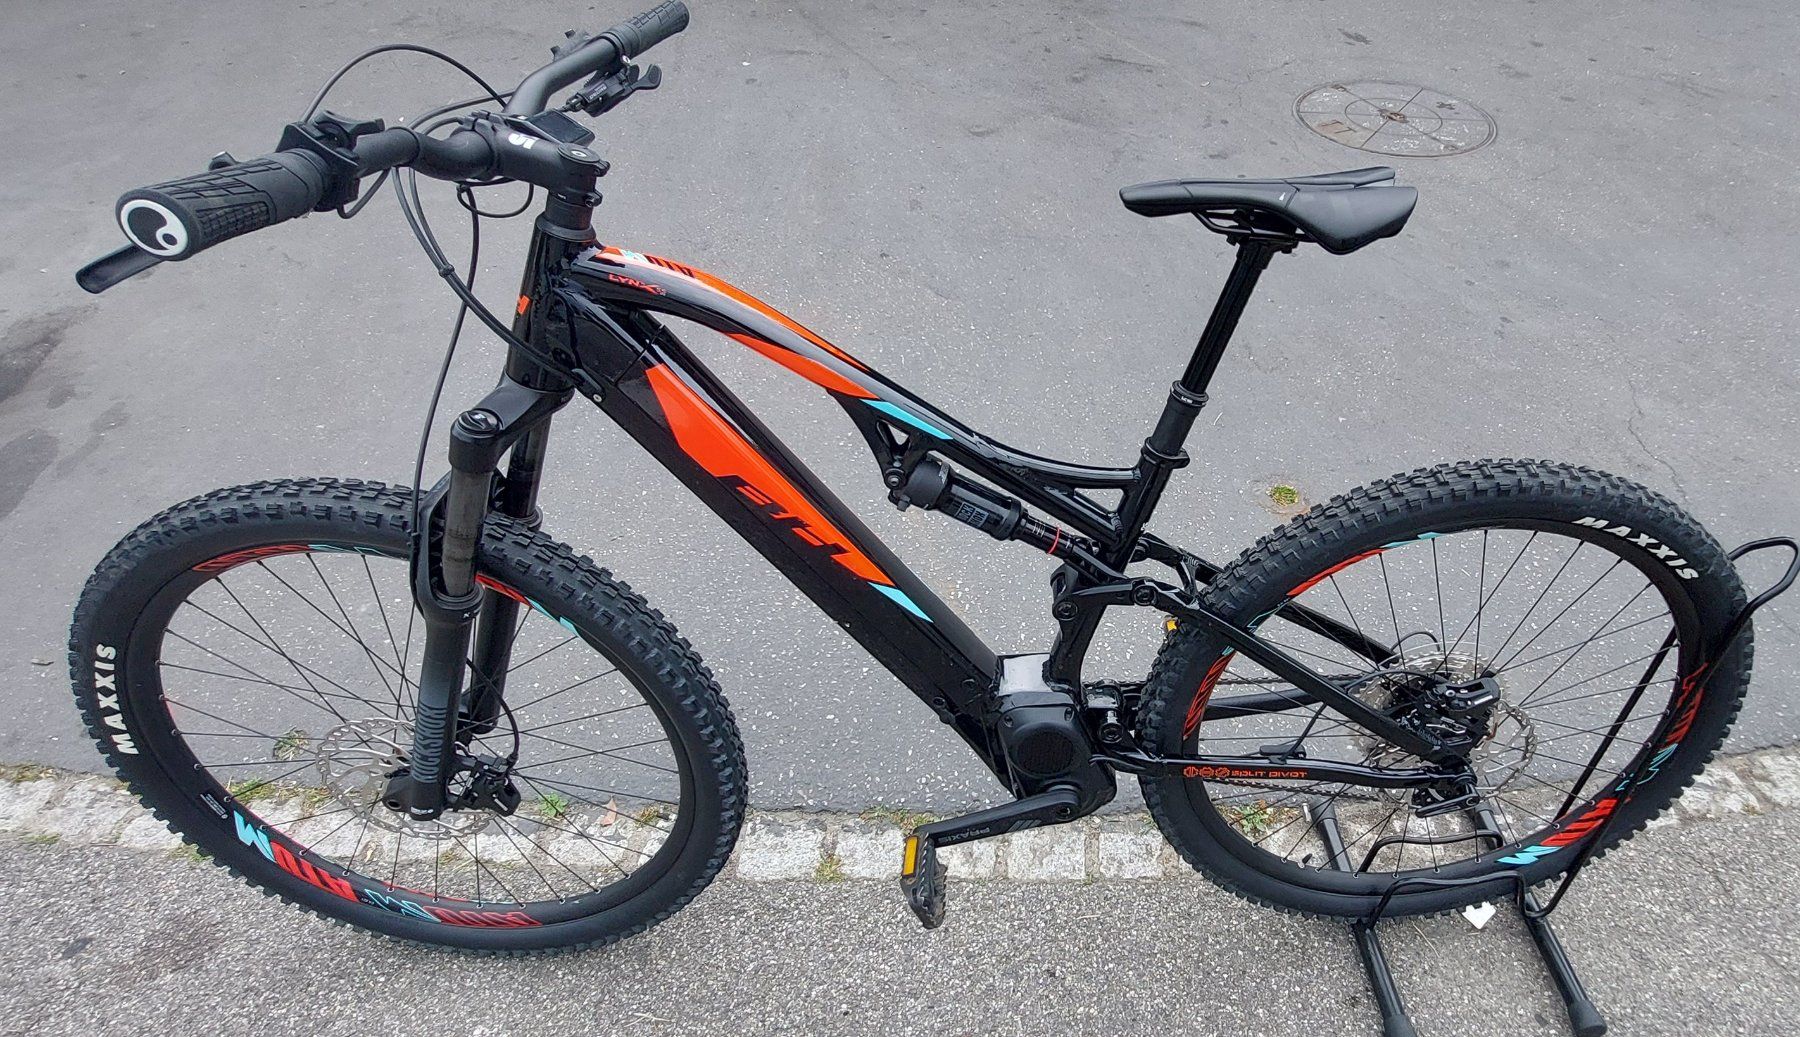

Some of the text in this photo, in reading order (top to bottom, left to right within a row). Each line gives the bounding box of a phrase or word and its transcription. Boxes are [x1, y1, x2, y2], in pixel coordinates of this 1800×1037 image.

[608, 273, 661, 296] LYNX
[1571, 516, 1700, 580] MAXXIS
[94, 643, 140, 755] MAXXIS
[411, 701, 448, 784] ROCKSHOX
[1231, 770, 1267, 778] SPLIT
[937, 826, 991, 844] PRAXIS
